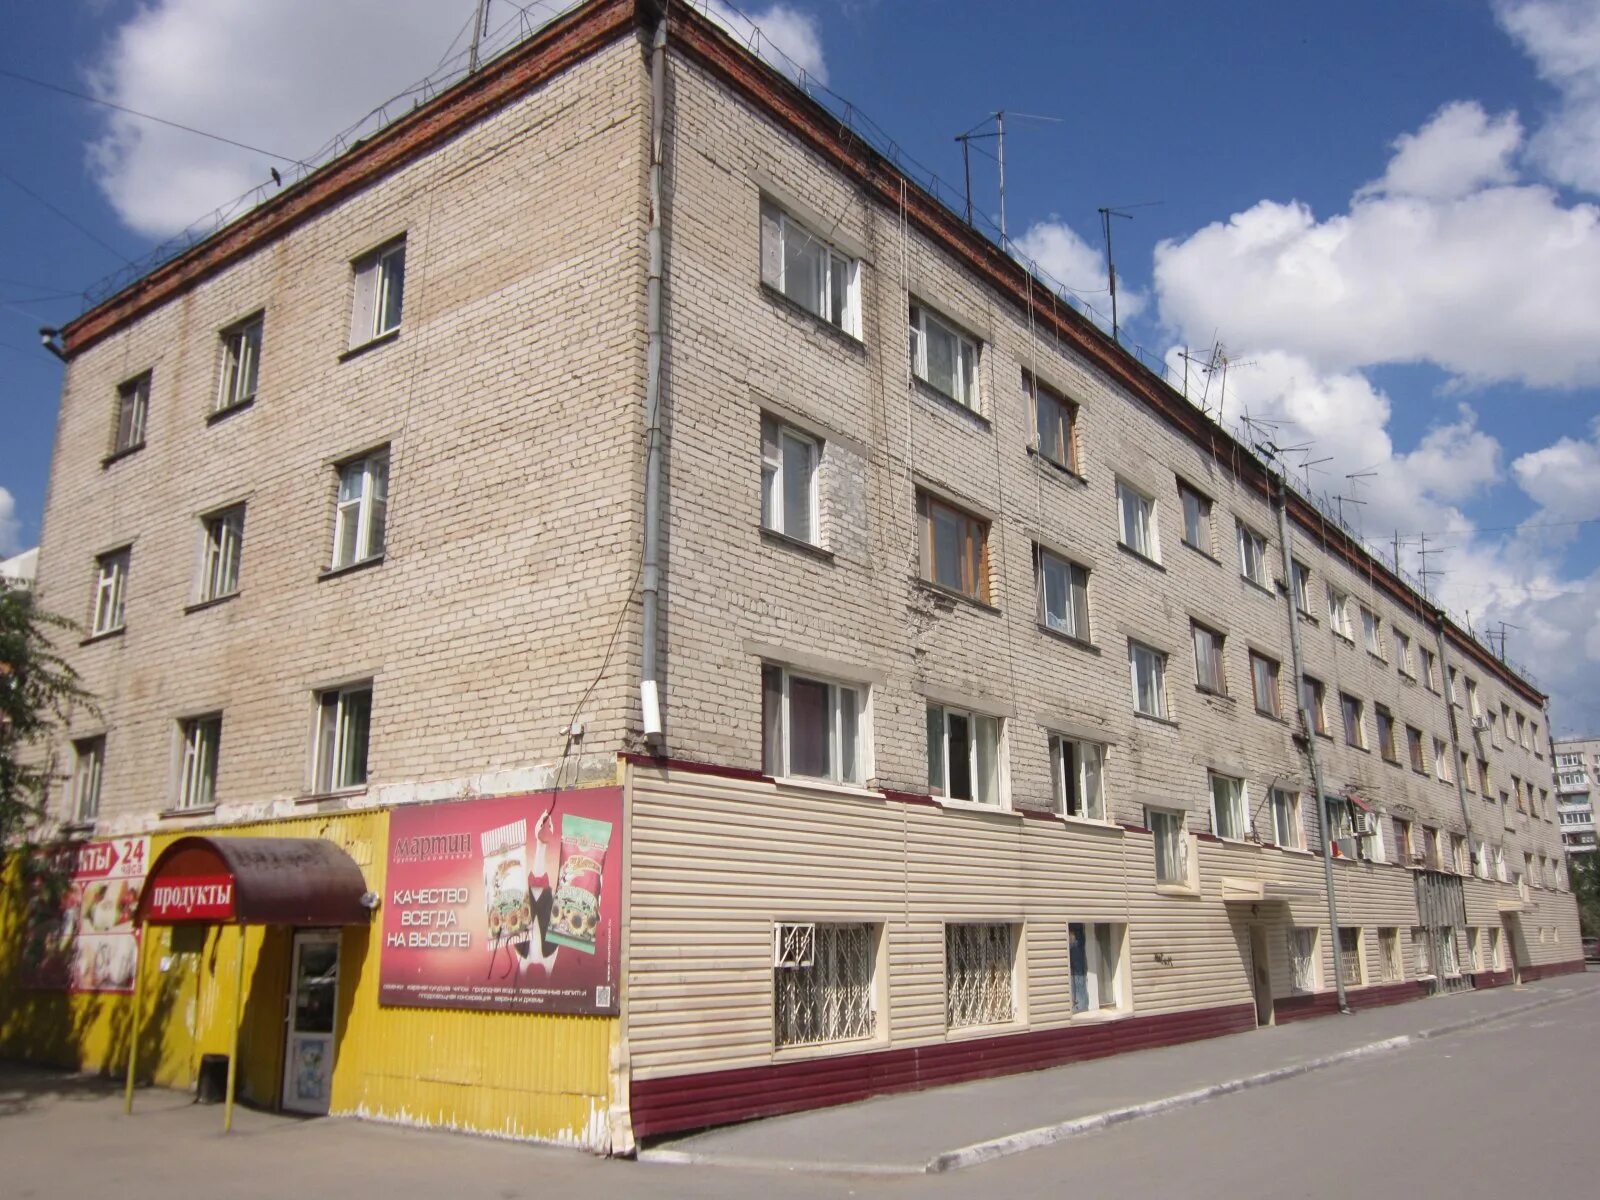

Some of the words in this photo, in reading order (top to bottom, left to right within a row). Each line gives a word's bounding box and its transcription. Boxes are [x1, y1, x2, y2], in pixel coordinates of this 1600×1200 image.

[123, 840, 144, 864] 24
[153, 884, 232, 915] продукты
[393, 887, 469, 905] КАЧЕСТВО
[401, 909, 457, 928] ВСЕГДА
[387, 931, 406, 947] НА
[408, 931, 472, 947] ВЫСОТЕ!
